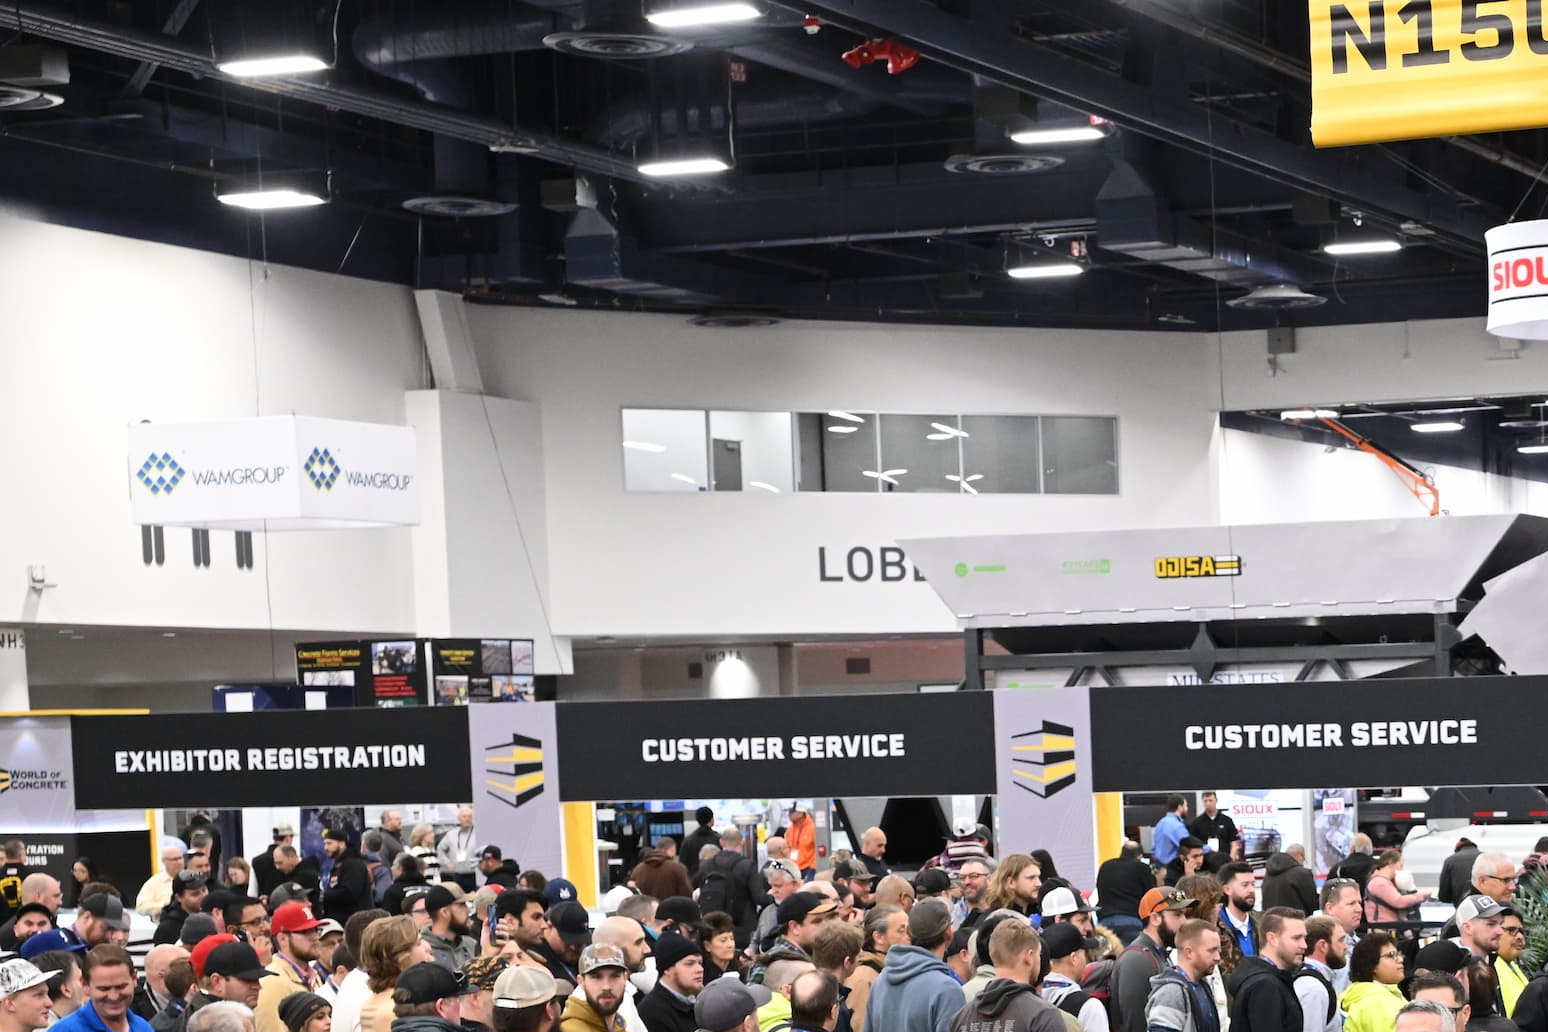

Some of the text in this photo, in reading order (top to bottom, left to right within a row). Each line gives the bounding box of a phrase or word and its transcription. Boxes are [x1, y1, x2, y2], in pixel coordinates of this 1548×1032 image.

[192, 467, 286, 486] WAMGROUP
[345, 470, 412, 491] WAMGROUP
[1185, 718, 1478, 751] CUSTOMER SERVICE
[642, 732, 906, 763] CUSTOMER SERVICE
[115, 744, 426, 774] EXHIBITOR REGISTRATION
[10, 770, 61, 780] WORLD OF
[10, 780, 66, 790] CONCRETE
[1232, 803, 1273, 815] SIOUX
